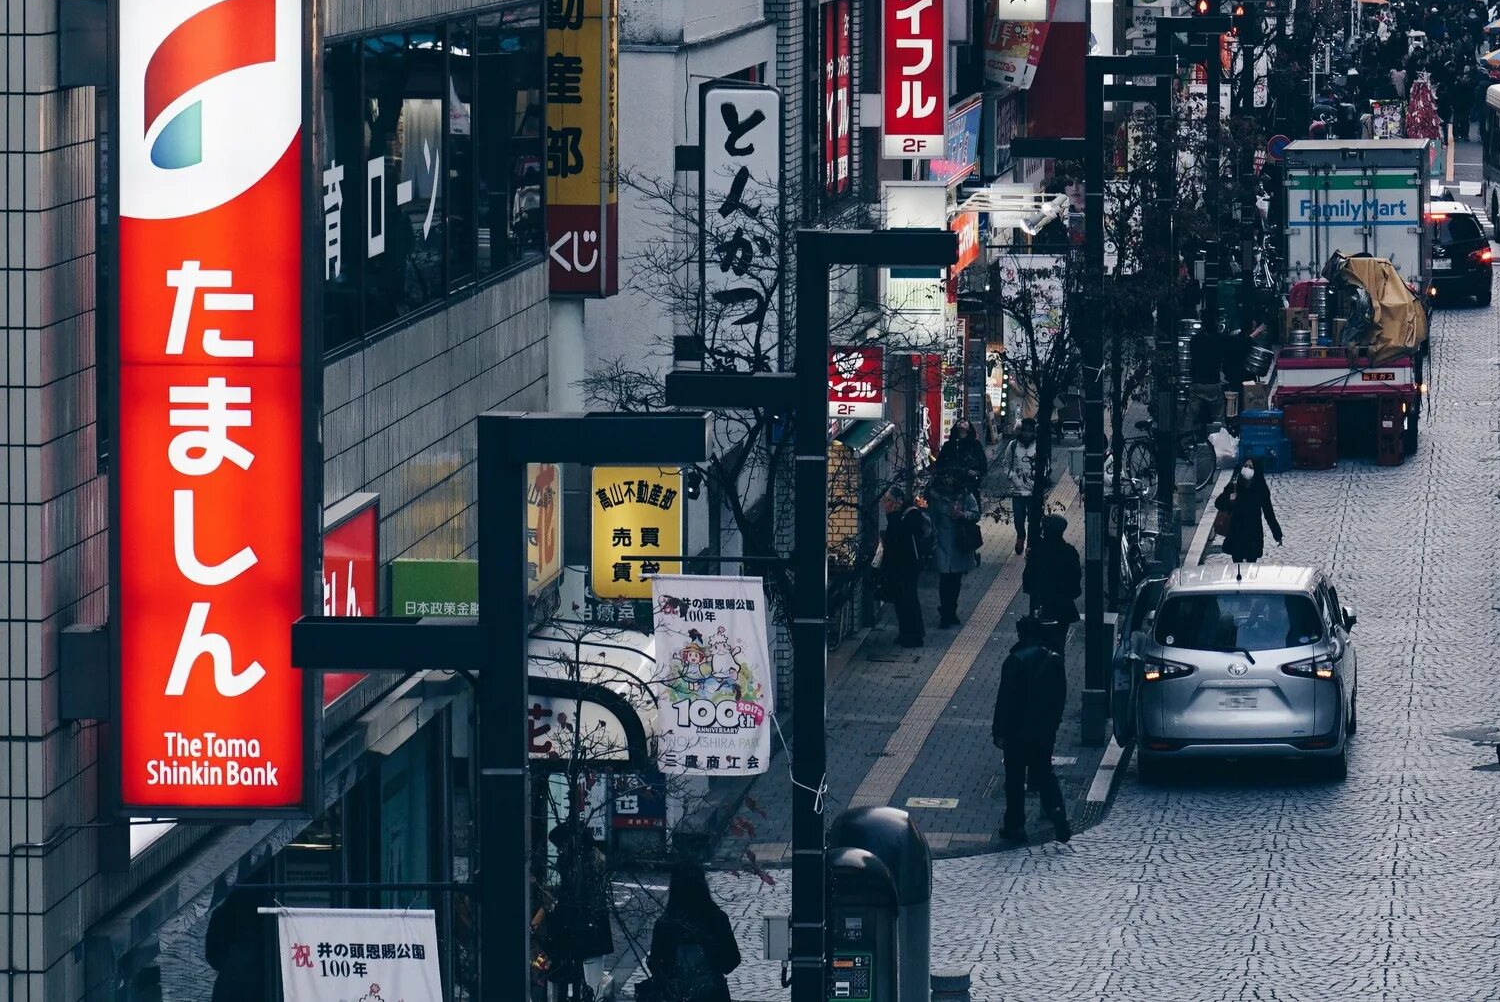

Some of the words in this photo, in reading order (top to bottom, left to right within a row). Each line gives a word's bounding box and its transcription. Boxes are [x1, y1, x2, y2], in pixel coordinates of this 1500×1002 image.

[902, 138, 927, 153] 2F
[1299, 198, 1407, 221] FamilyMart
[828, 380, 877, 399] イフル
[837, 403, 856, 415] 2F
[164, 260, 267, 698] たましん
[595, 479, 678, 512] 高山不動産部
[612, 527, 660, 548] 売買
[164, 731, 202, 758] The
[203, 731, 261, 758] Tama
[665, 754, 760, 770] 三鷹商工会
[146, 760, 223, 788] Shinkin
[226, 760, 279, 788] Bank
[291, 942, 315, 968] 祝
[317, 941, 426, 961] 井の頭恩賜公園
[320, 959, 368, 978] 100年
